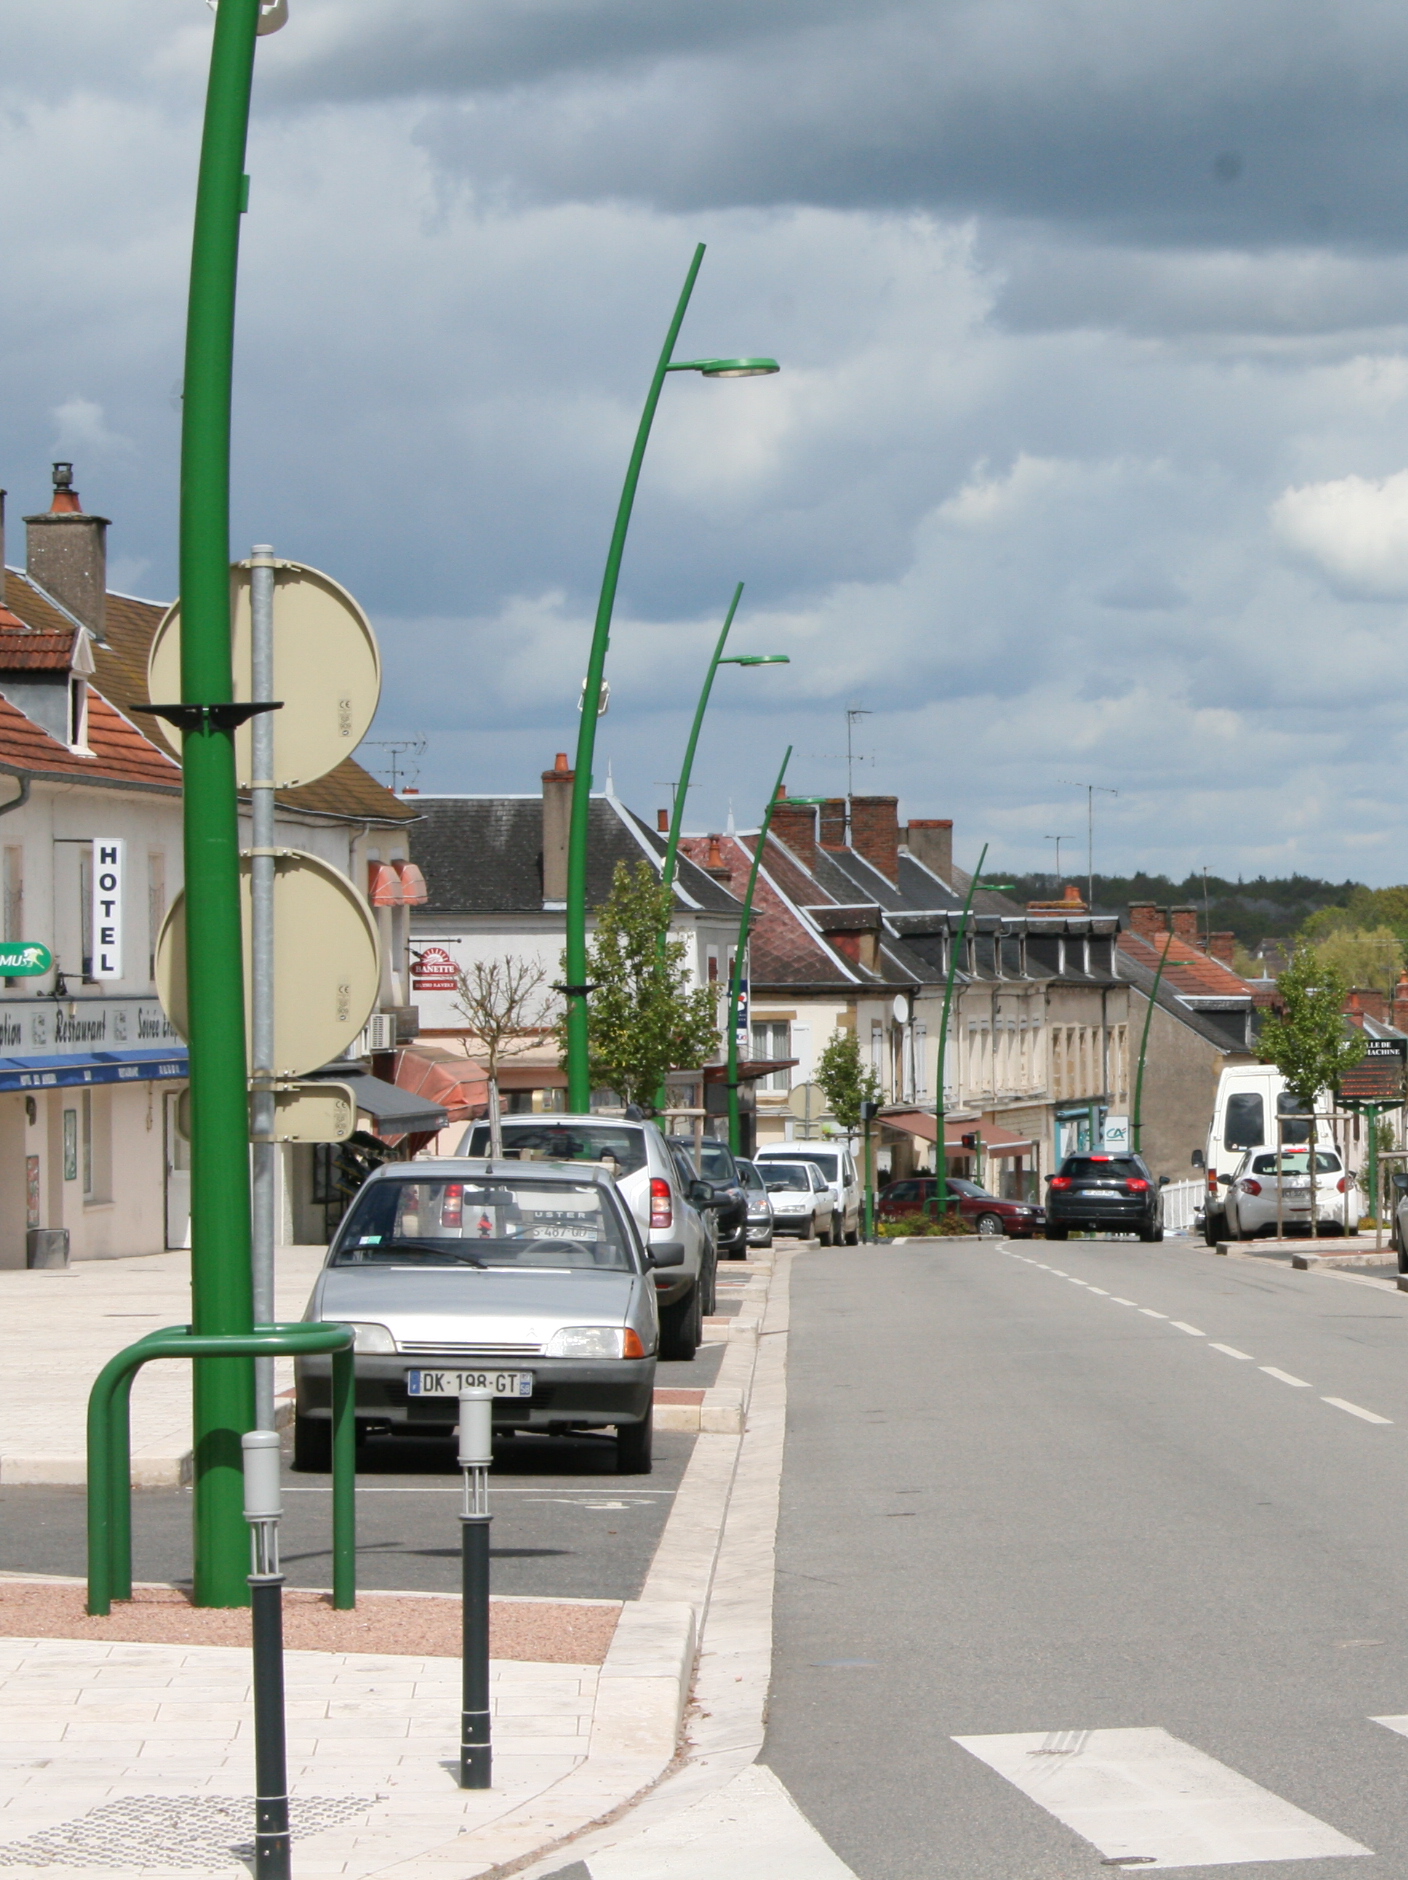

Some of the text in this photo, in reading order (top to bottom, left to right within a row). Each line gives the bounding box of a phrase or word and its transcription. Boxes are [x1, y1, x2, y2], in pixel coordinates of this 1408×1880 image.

[100, 847, 117, 971] HOTEL
[55, 1009, 105, 1042] Restaurant
[534, 1211, 586, 1219] USTER
[423, 1373, 518, 1393] DK-198-GT
